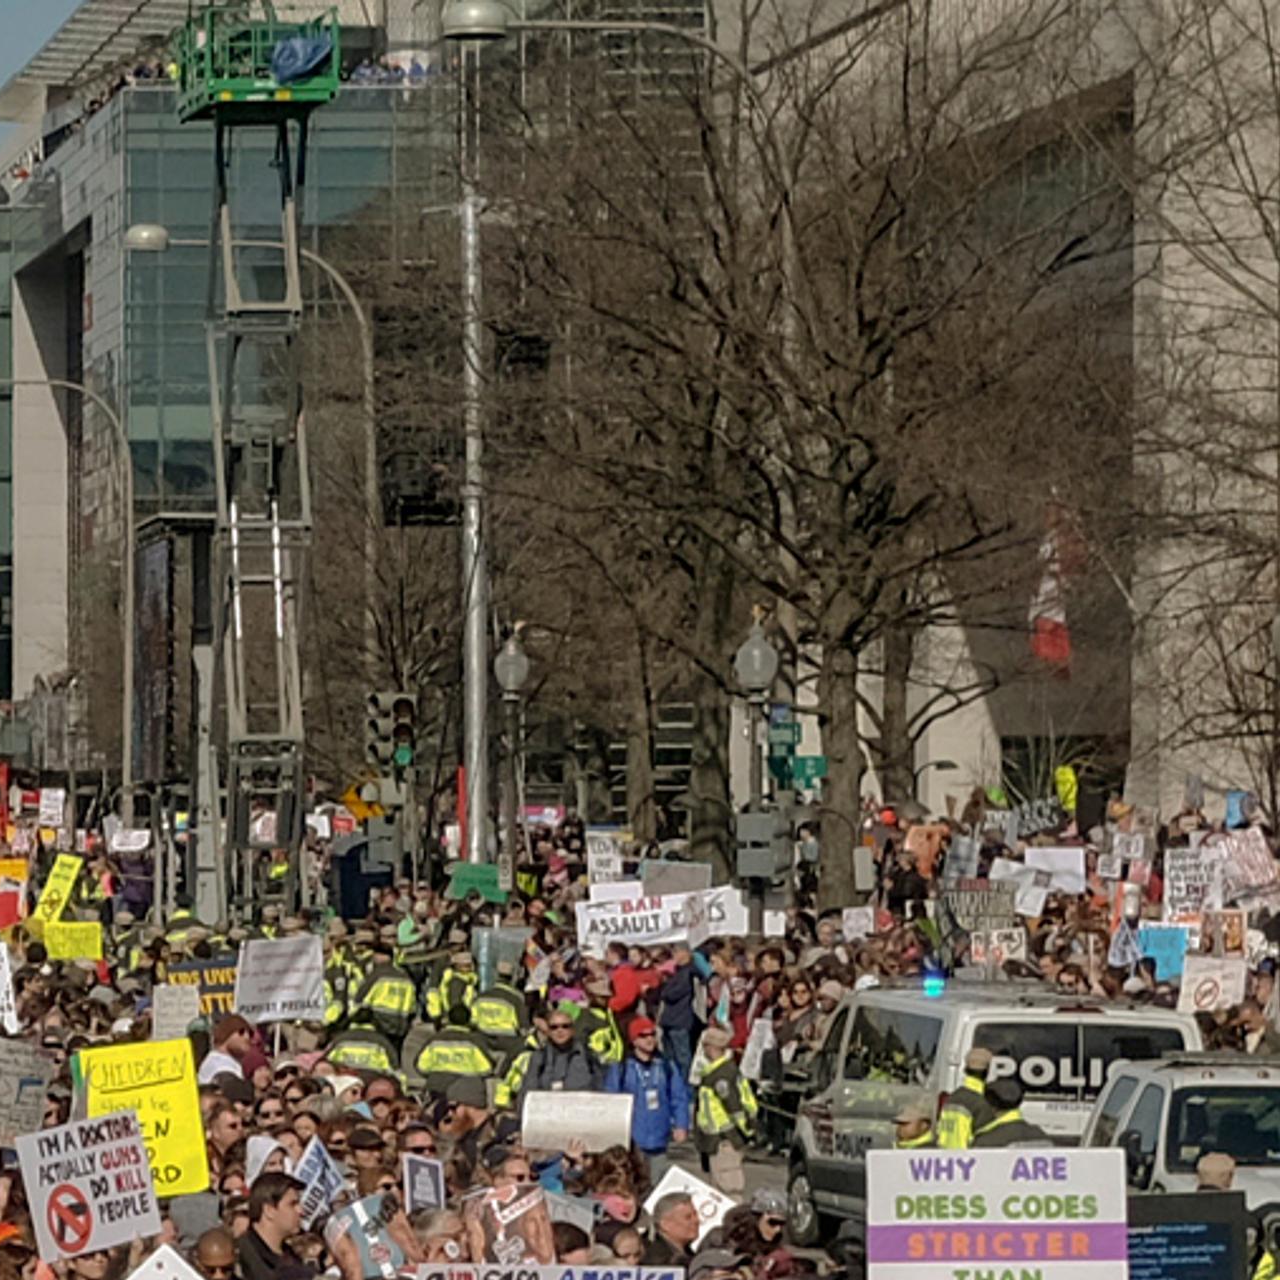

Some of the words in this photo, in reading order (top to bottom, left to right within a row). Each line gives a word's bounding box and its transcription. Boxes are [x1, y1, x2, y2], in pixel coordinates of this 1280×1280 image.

[620, 897, 662, 913] BAN
[589, 915, 660, 935] ASSAULT
[39, 1153, 96, 1187] ACTUALLY
[100, 1145, 140, 1170] GUNS
[910, 1158, 975, 1180] WHY
[1012, 1158, 1067, 1179] ARE
[91, 1177, 109, 1198] DO
[115, 1168, 146, 1192] KILL
[98, 1193, 150, 1224] PEOPLE
[895, 1197, 986, 1219] DRESS
[1002, 1196, 1098, 1218] CODES
[907, 1233, 1089, 1257] STRICTER
